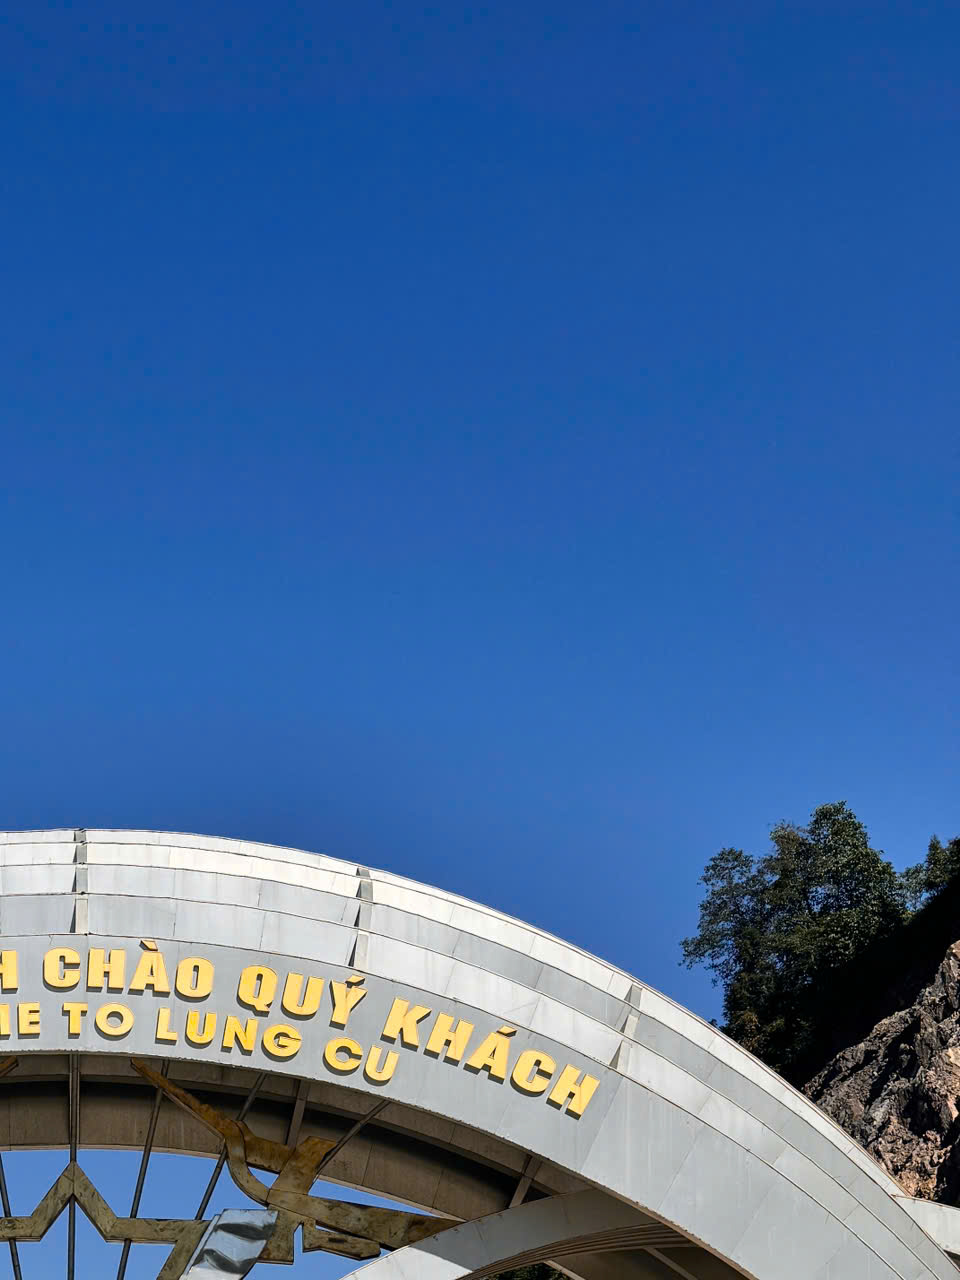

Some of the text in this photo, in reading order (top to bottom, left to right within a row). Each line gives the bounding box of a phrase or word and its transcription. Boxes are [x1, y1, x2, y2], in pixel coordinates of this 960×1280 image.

[43, 941, 215, 998] CHÀO
[238, 964, 367, 1027] QUÝ
[382, 996, 600, 1119] KHÁCH
[62, 1001, 135, 1037] TO
[156, 1006, 302, 1059] LUNG
[324, 1036, 400, 1085] CU
